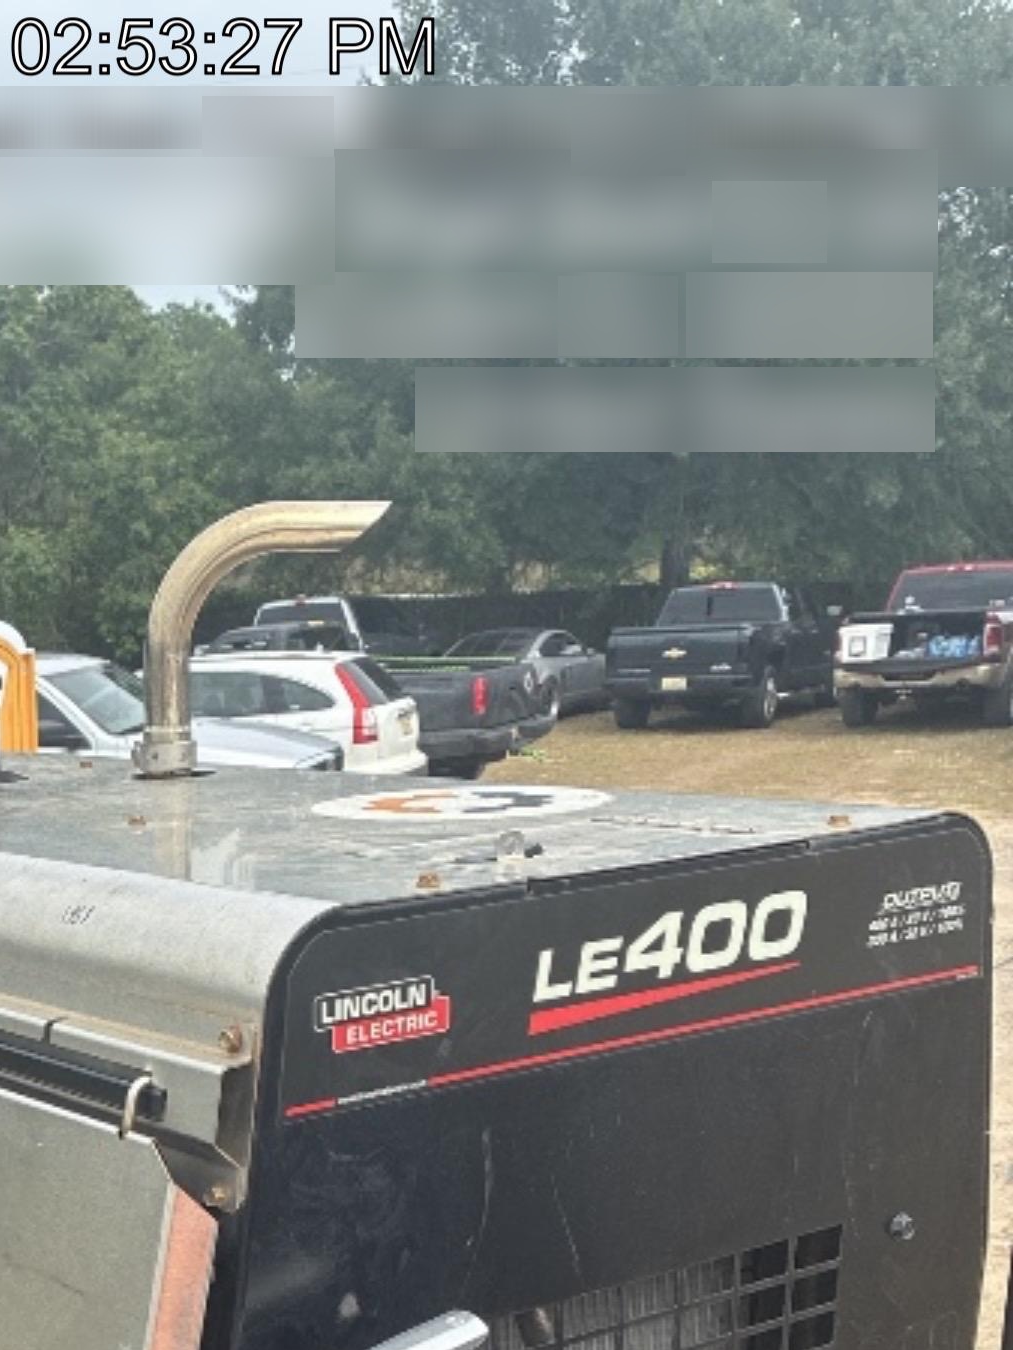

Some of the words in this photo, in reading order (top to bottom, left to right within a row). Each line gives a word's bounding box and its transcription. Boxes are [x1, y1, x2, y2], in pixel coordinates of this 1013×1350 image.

[533, 889, 808, 1003] LE400
[321, 983, 426, 1024] LINCOLN
[346, 1010, 438, 1045] ELECTRIC
